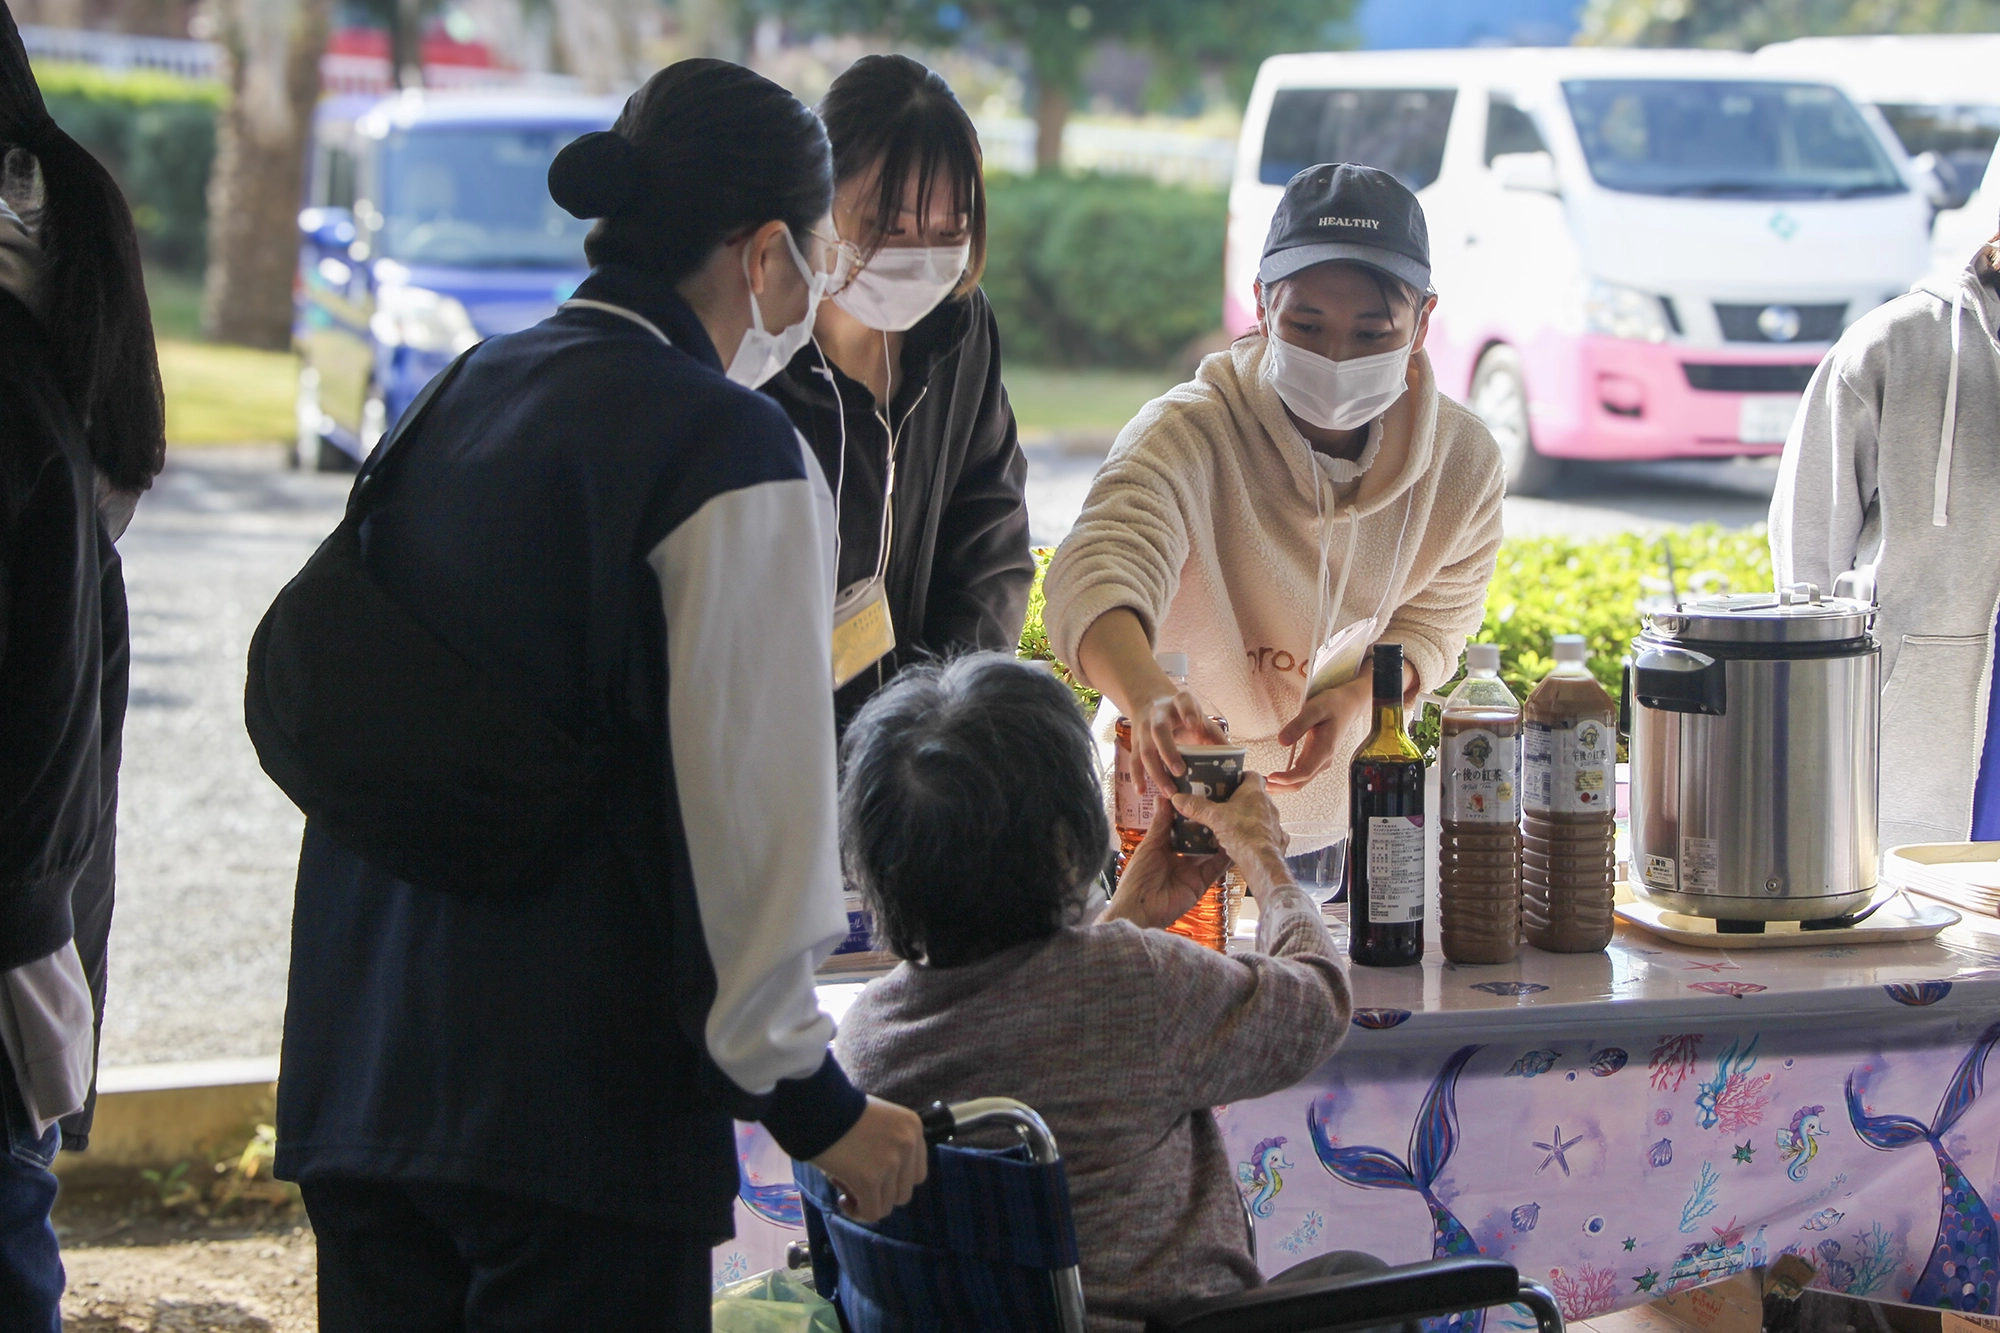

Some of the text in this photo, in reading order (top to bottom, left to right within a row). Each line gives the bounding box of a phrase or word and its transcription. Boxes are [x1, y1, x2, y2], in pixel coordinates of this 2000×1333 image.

[1318, 216, 1379, 230] HEALTHY
[1572, 749, 1607, 762] 午後の紅茶
[1452, 767, 1503, 782] 午後の紅茶
